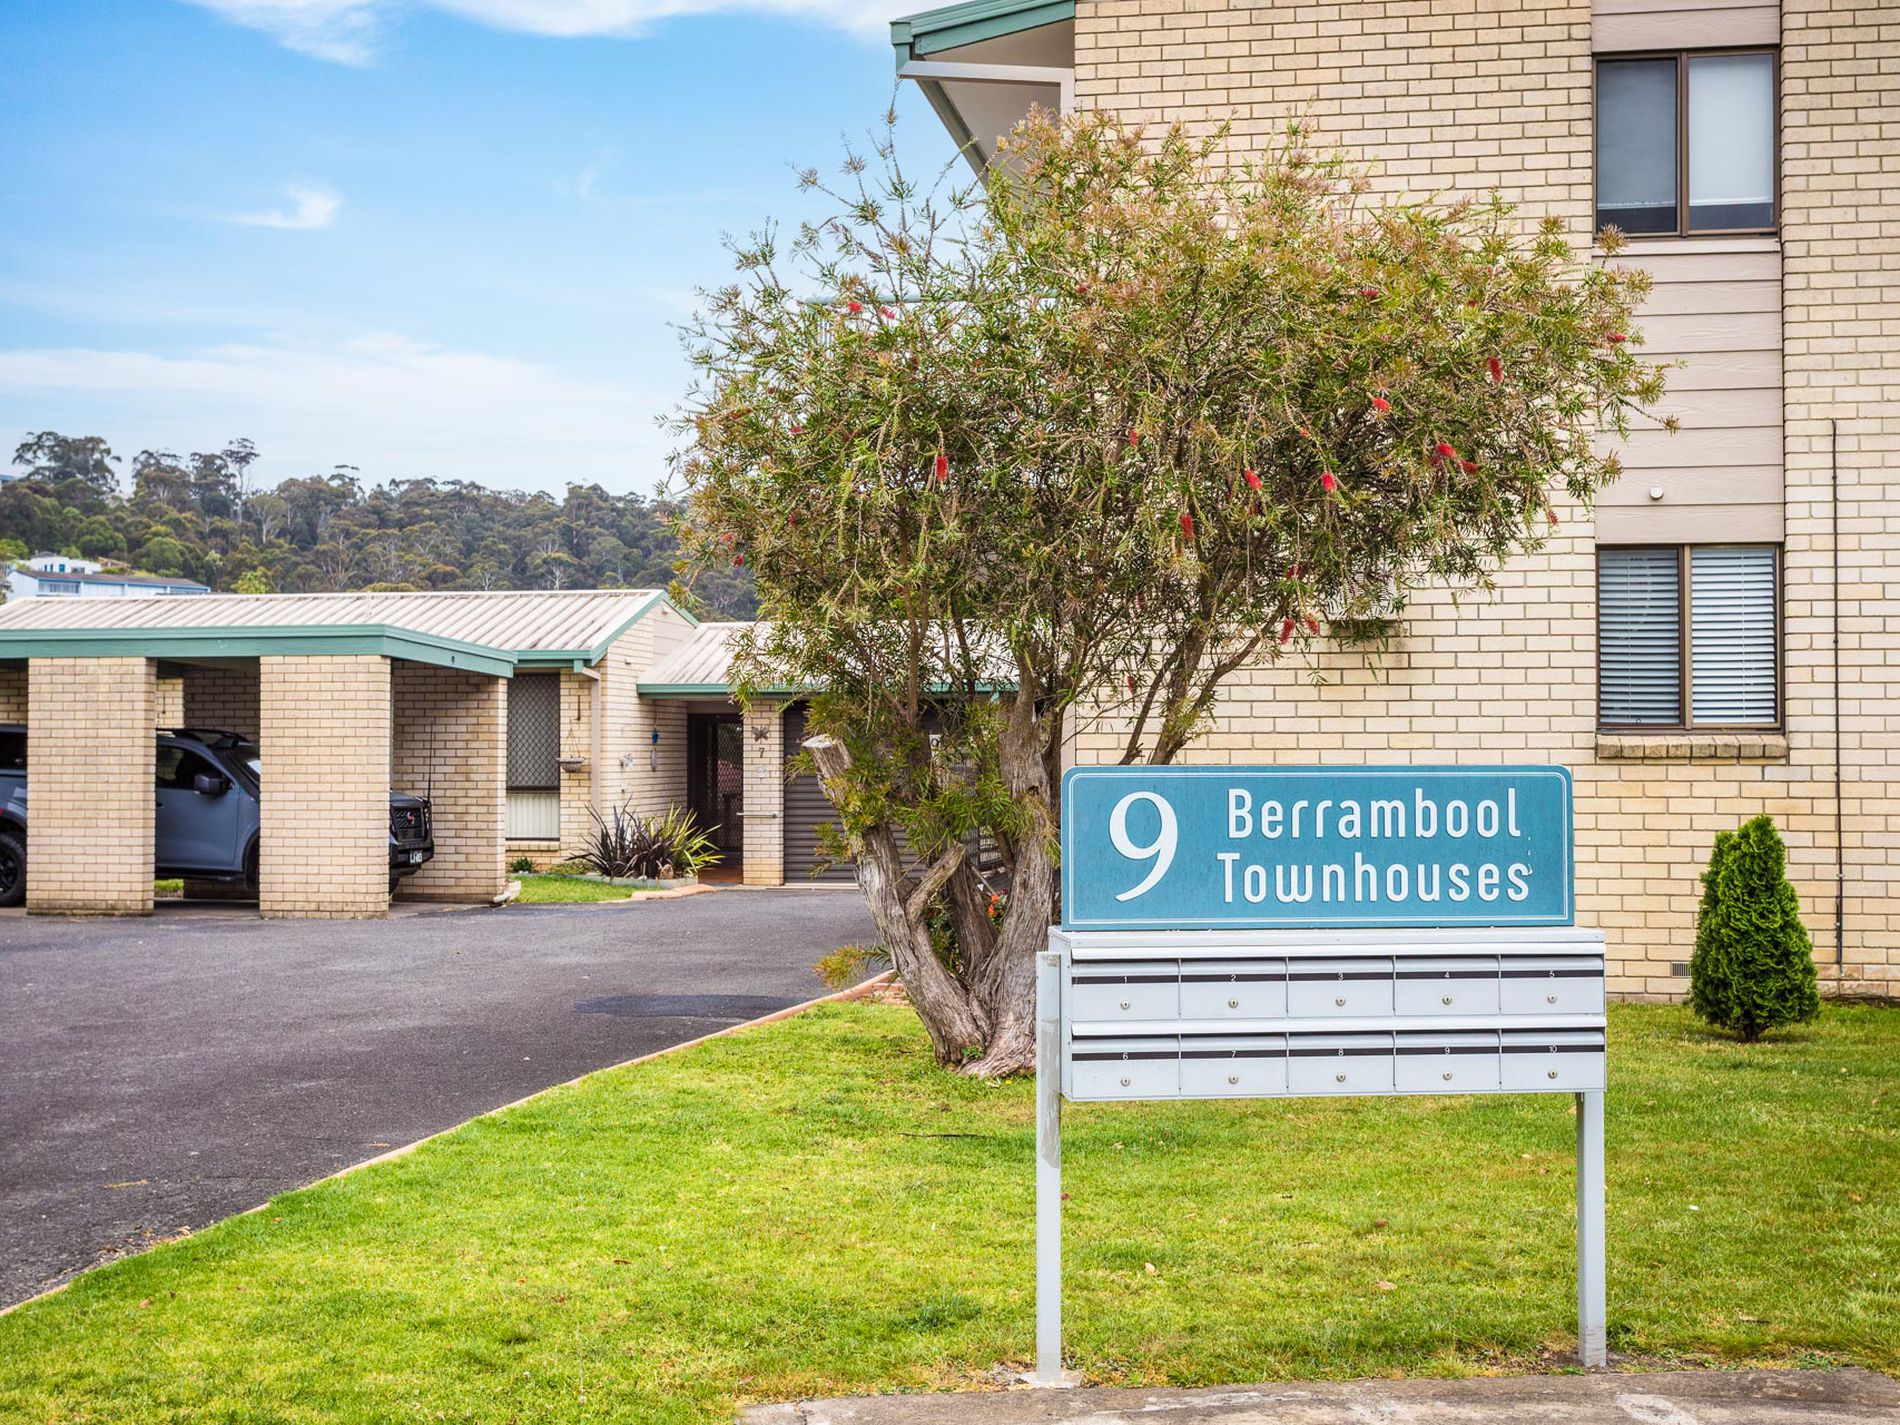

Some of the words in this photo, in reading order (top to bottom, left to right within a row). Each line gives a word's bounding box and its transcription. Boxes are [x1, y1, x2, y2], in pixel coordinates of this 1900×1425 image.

[758, 747, 765, 758] 7
[1228, 788, 1521, 839] Berrambool
[1109, 791, 1178, 902] 9
[1217, 851, 1530, 903] Townhouses
[1230, 973, 1237, 982] 2
[1337, 972, 1344, 981] 3
[1444, 971, 1450, 979] 4
[1549, 970, 1555, 978] 5
[1123, 975, 1128, 984] 1
[1338, 1048, 1344, 1056] 8
[1444, 1047, 1451, 1055] 9
[1549, 1045, 1557, 1053] 10
[1122, 1052, 1129, 1061] 6
[1231, 1050, 1237, 1059] 7
